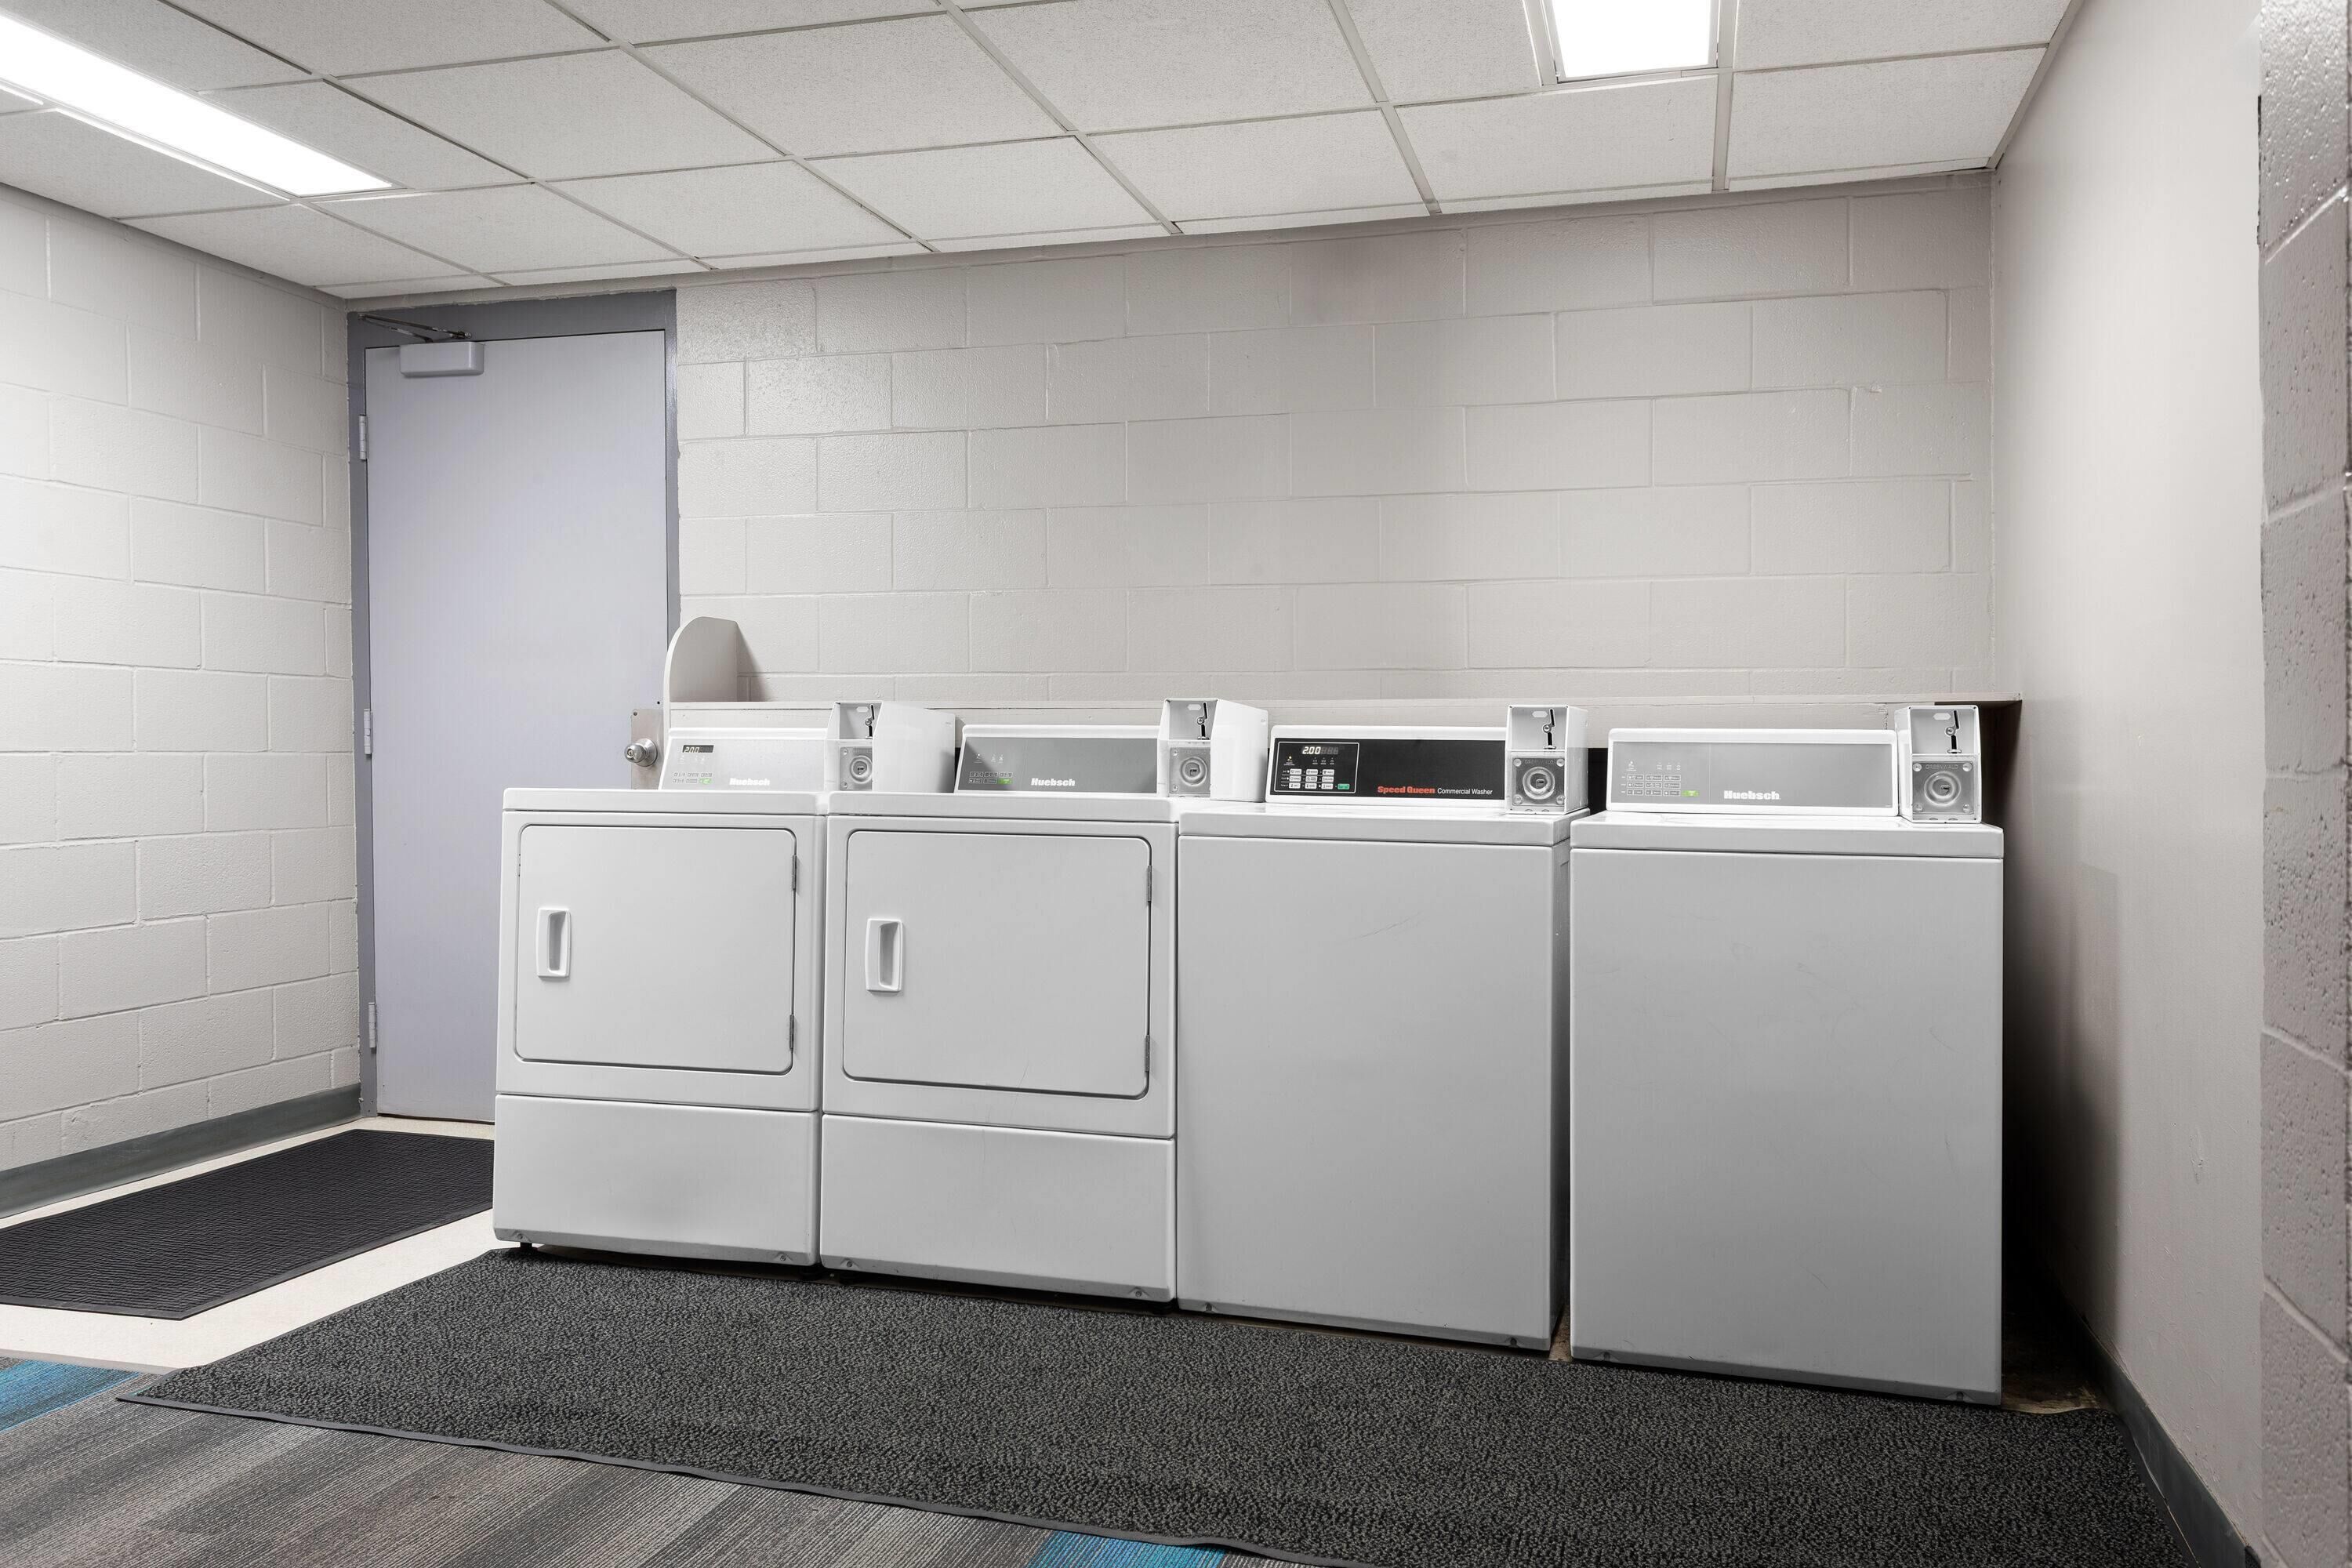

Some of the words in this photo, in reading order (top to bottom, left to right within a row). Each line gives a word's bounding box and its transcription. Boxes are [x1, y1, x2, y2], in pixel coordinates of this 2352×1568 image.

[1031, 778, 1076, 786] Huebsch
[1377, 786, 1406, 794] Speed
[1724, 790, 1780, 800] Huebsch
